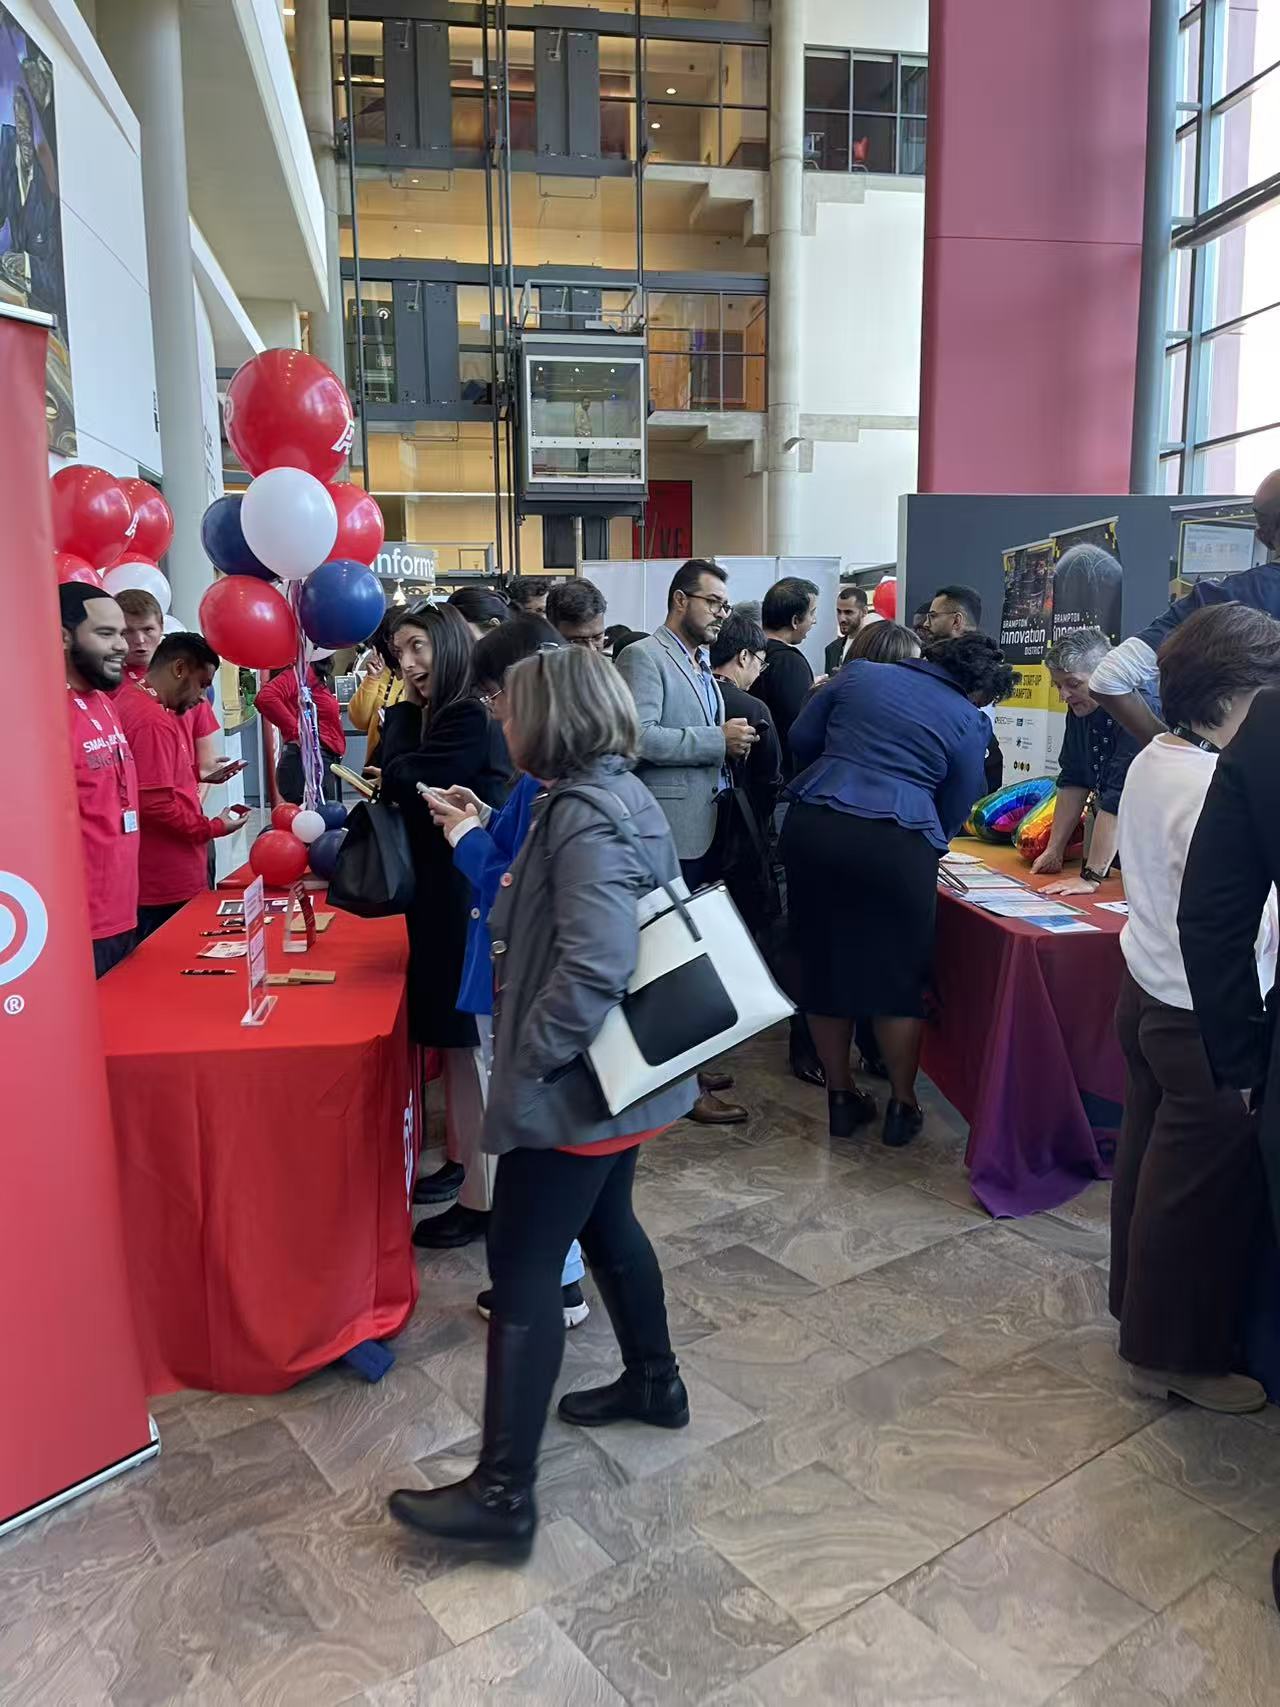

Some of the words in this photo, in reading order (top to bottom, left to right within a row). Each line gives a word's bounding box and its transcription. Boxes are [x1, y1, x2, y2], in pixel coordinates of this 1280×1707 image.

[1054, 613, 1080, 623] BRAMPTON
[1003, 619, 1028, 629] BRAMPTON
[1001, 629, 1046, 645] innovation
[1024, 646, 1044, 656] DISTRICT
